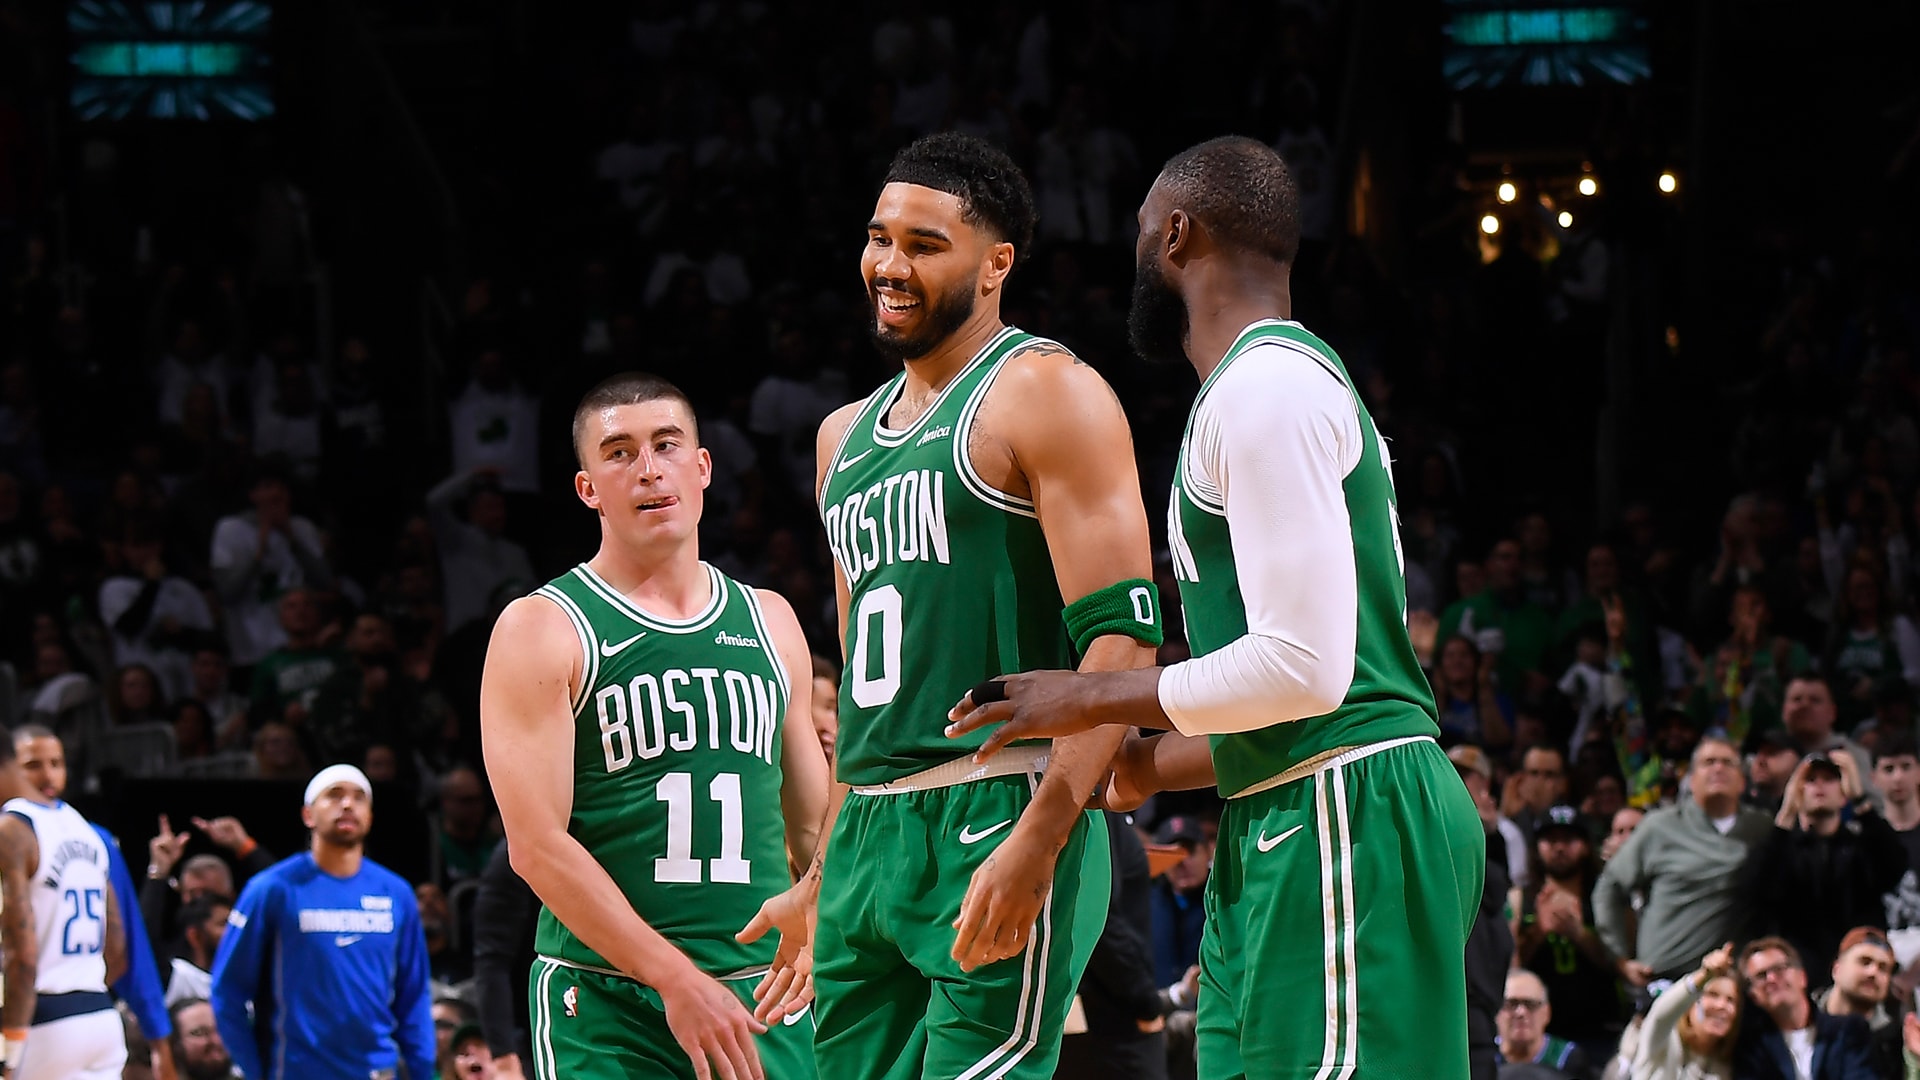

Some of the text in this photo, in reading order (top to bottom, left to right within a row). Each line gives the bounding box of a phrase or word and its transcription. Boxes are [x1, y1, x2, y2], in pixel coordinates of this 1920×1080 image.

[916, 425, 951, 447] Amica
[826, 469, 950, 594] BOSTON
[714, 630, 760, 648] Amica
[852, 583, 903, 709] 0
[1128, 586, 1155, 625] 0
[595, 668, 777, 774] BOSTON
[654, 772, 751, 884] 11
[61, 888, 104, 956] 25
